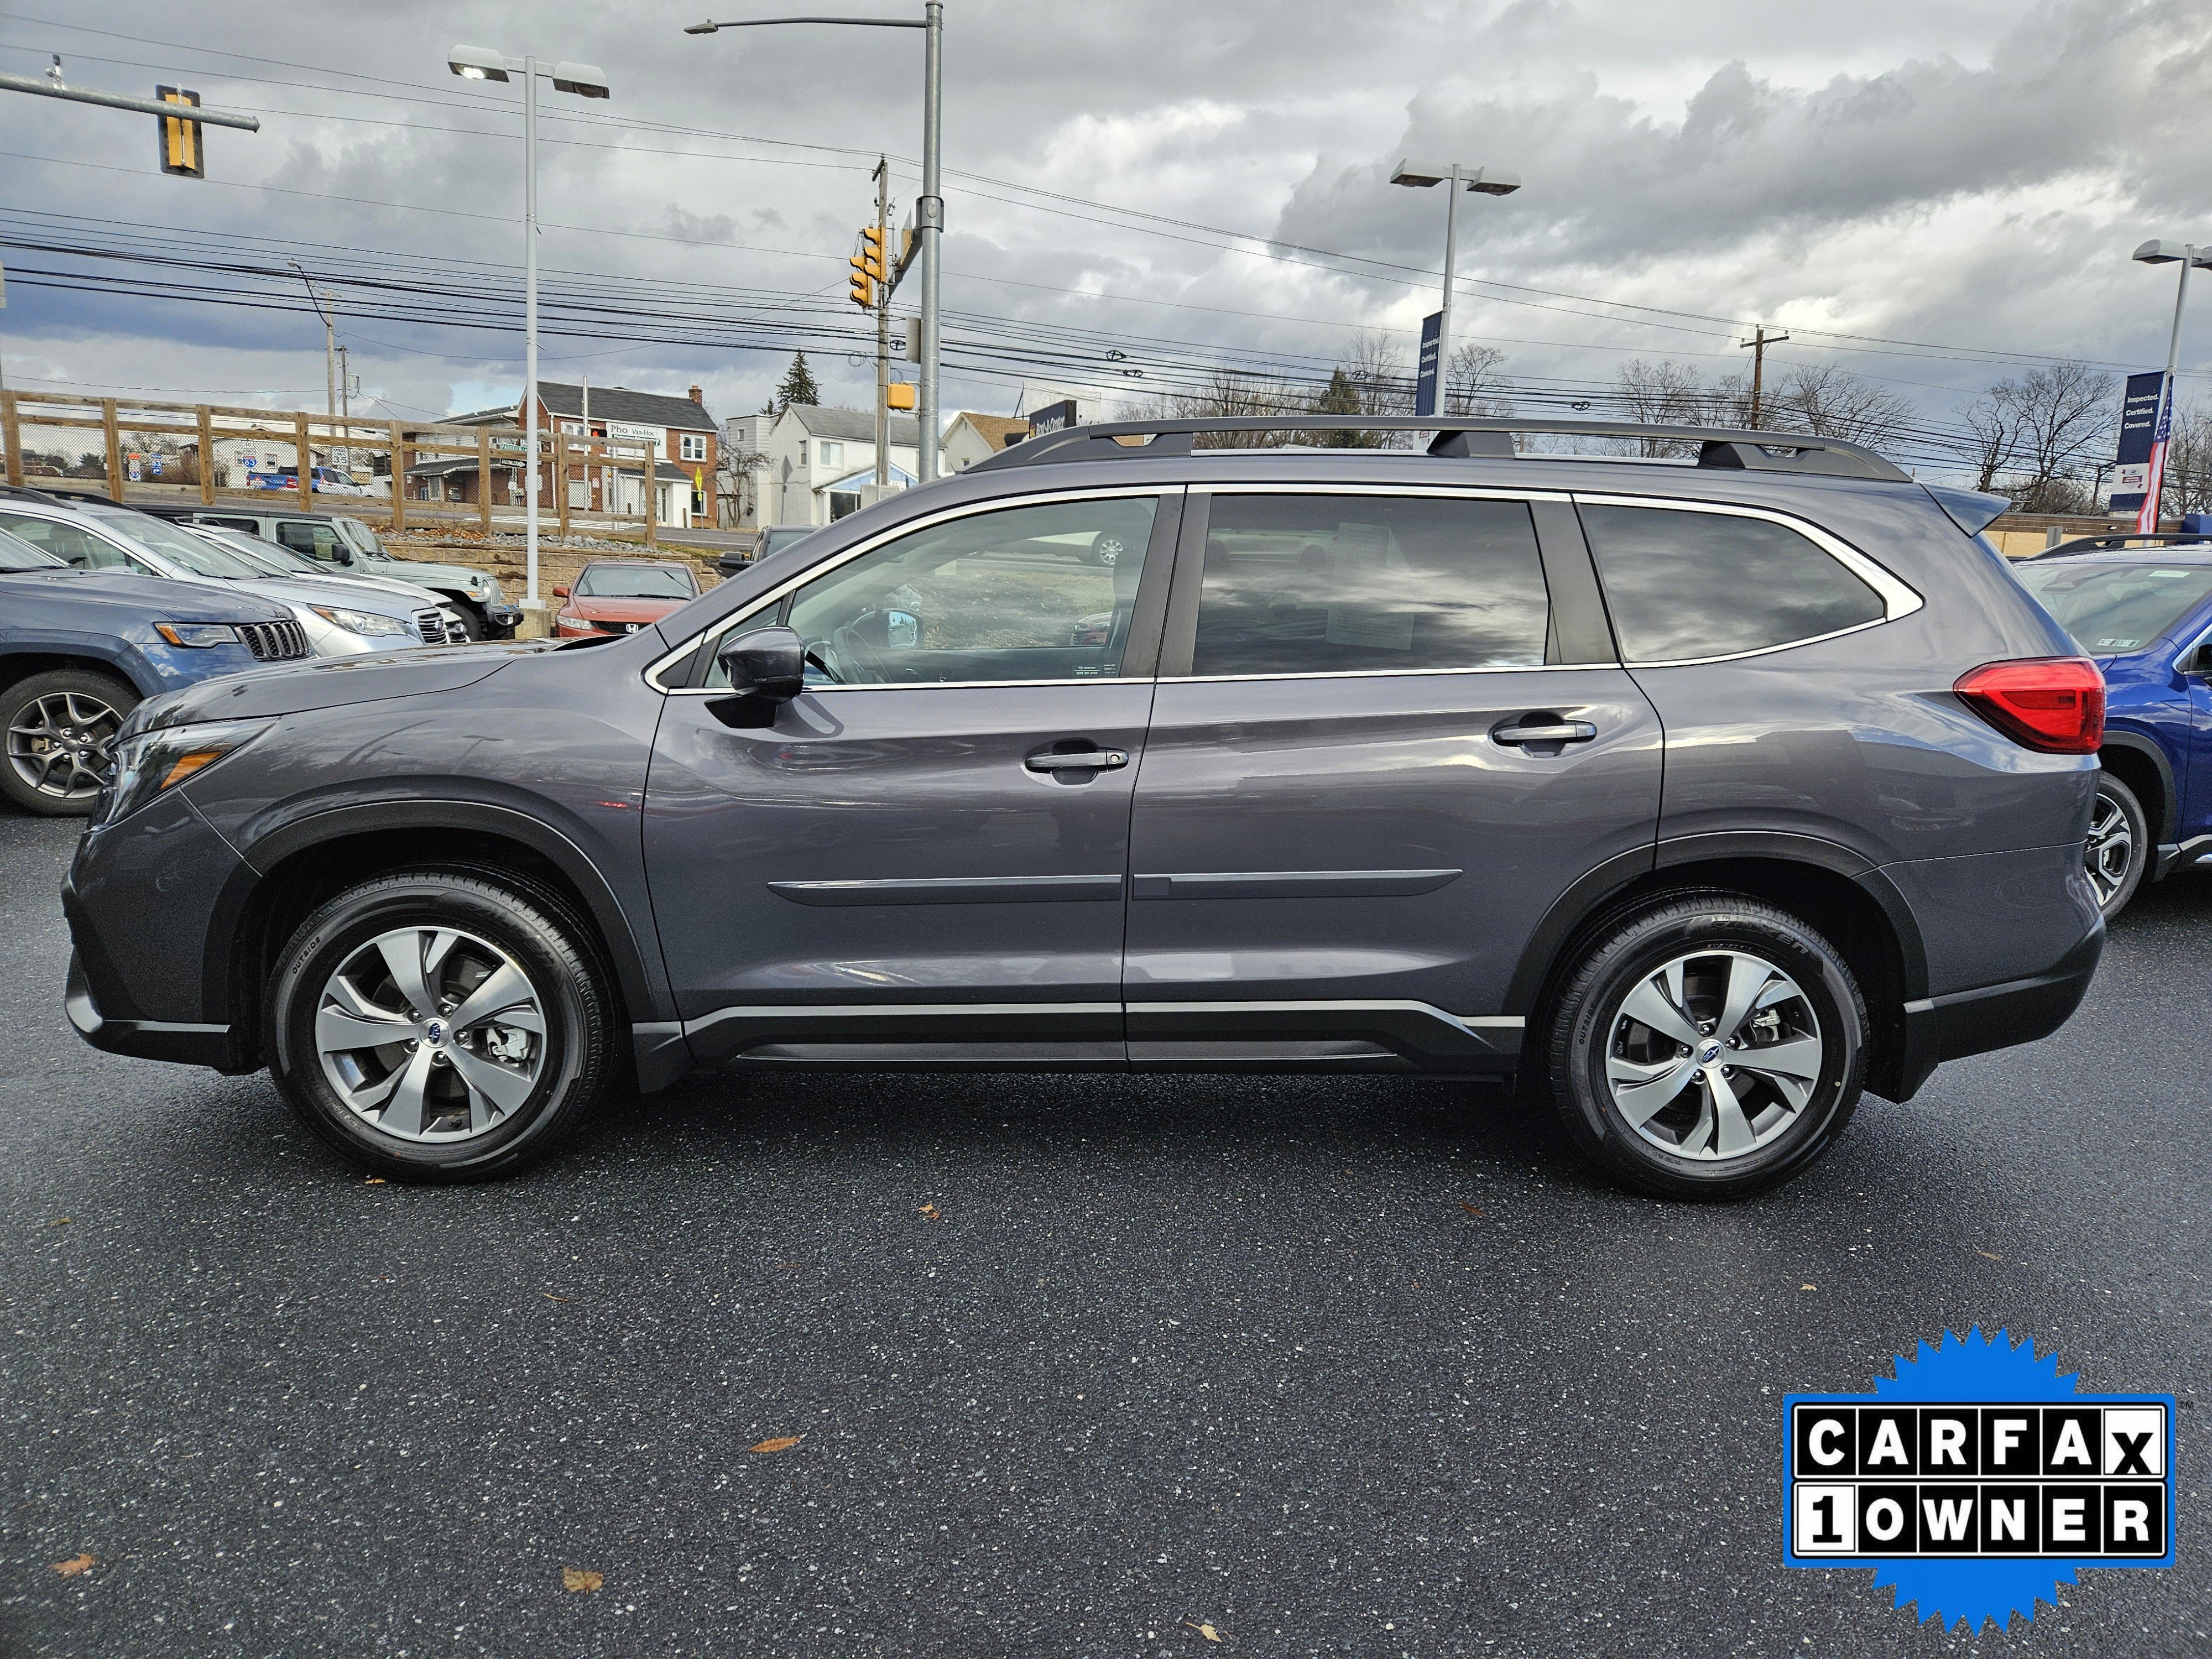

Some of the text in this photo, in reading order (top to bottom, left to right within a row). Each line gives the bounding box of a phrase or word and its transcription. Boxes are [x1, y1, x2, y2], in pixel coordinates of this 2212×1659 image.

[2127, 394, 2159, 403] Inspected.
[2126, 407, 2154, 416] Certified.
[2124, 420, 2151, 429] Covered.
[611, 425, 628, 434] Pho
[292, 936, 321, 974] OUTSIDE
